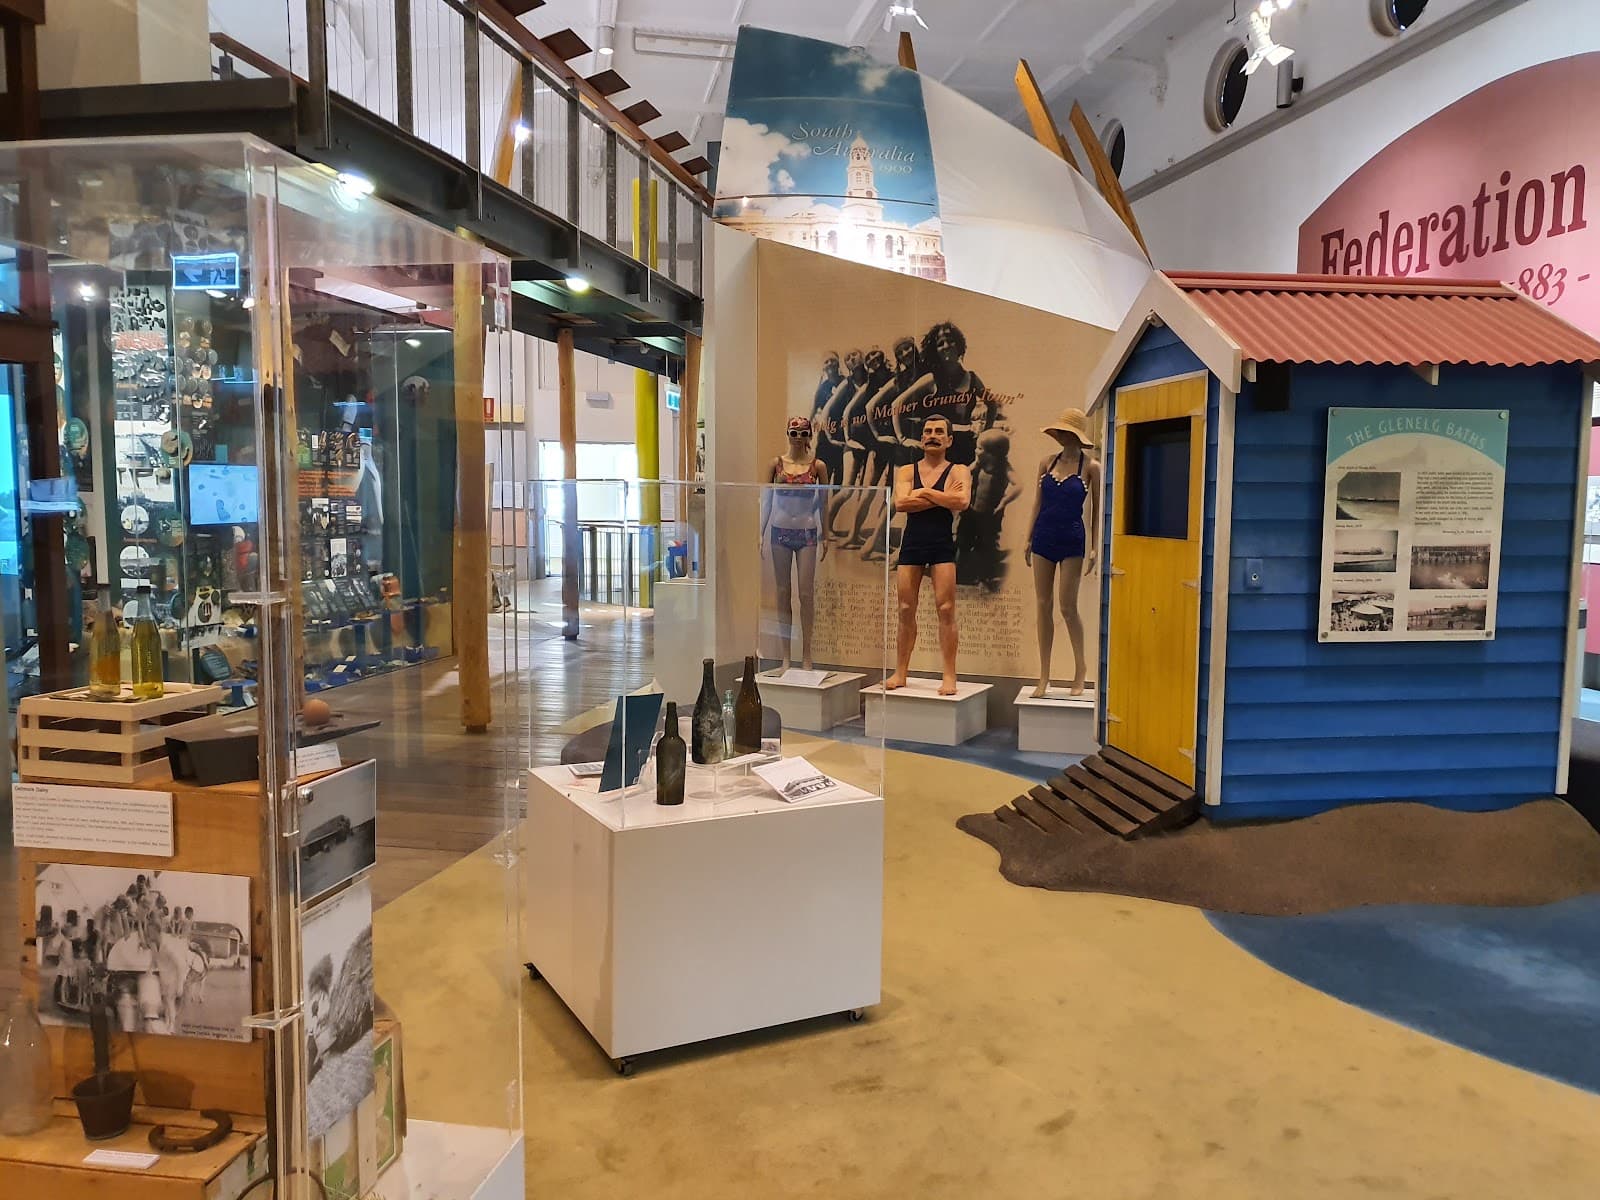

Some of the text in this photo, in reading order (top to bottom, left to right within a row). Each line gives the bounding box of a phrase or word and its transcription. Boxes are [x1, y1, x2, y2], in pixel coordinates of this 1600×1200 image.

[791, 121, 853, 141] South
[1320, 163, 1588, 278] Federation
[1509, 262, 1568, 306] 883
[1345, 416, 1487, 450] THE GLENELG BATHS
